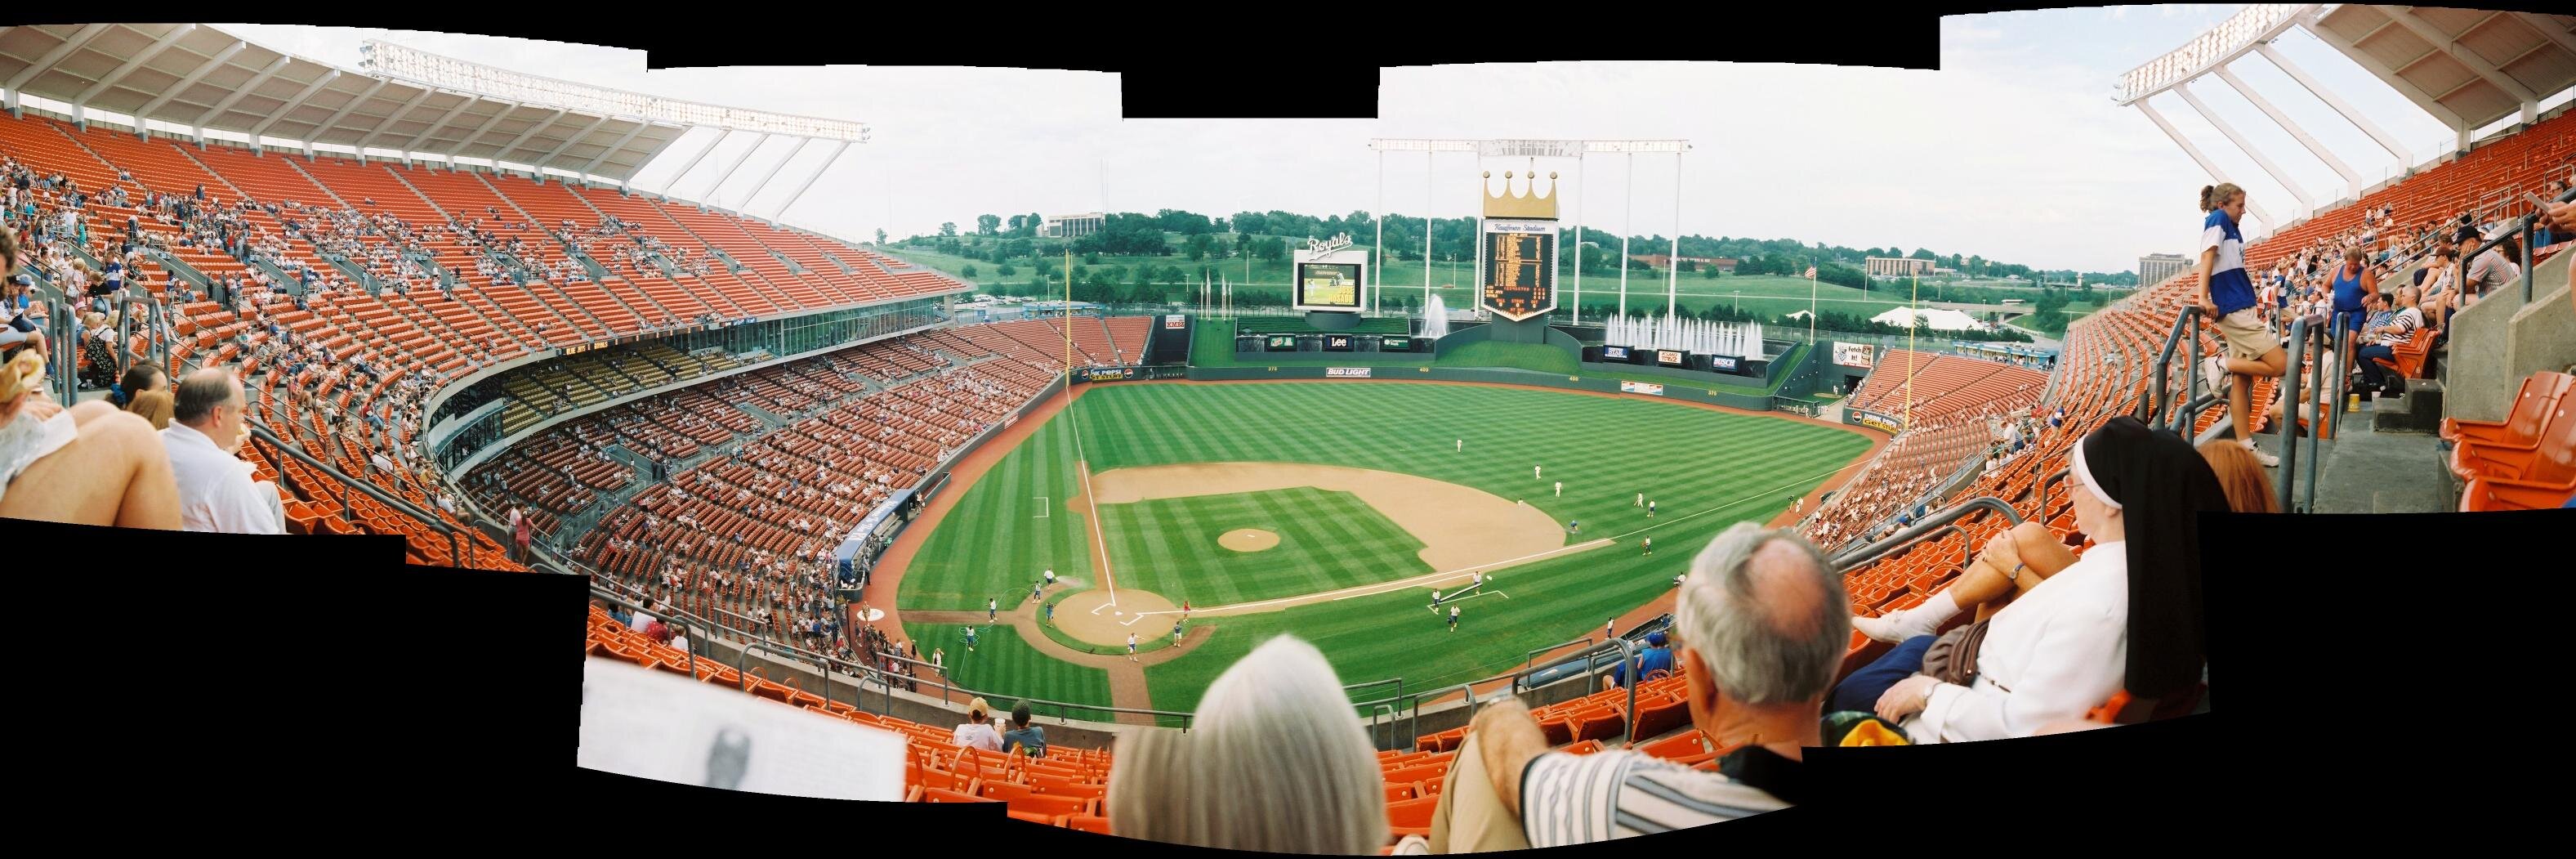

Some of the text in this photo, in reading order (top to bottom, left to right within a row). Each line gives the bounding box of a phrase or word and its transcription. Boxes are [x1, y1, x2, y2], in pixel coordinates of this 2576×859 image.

[1307, 231, 1353, 258] Royals
[1332, 338, 1346, 347] Lee
[1713, 358, 1735, 366] BUSCH
[1864, 413, 1882, 423] DRINK
